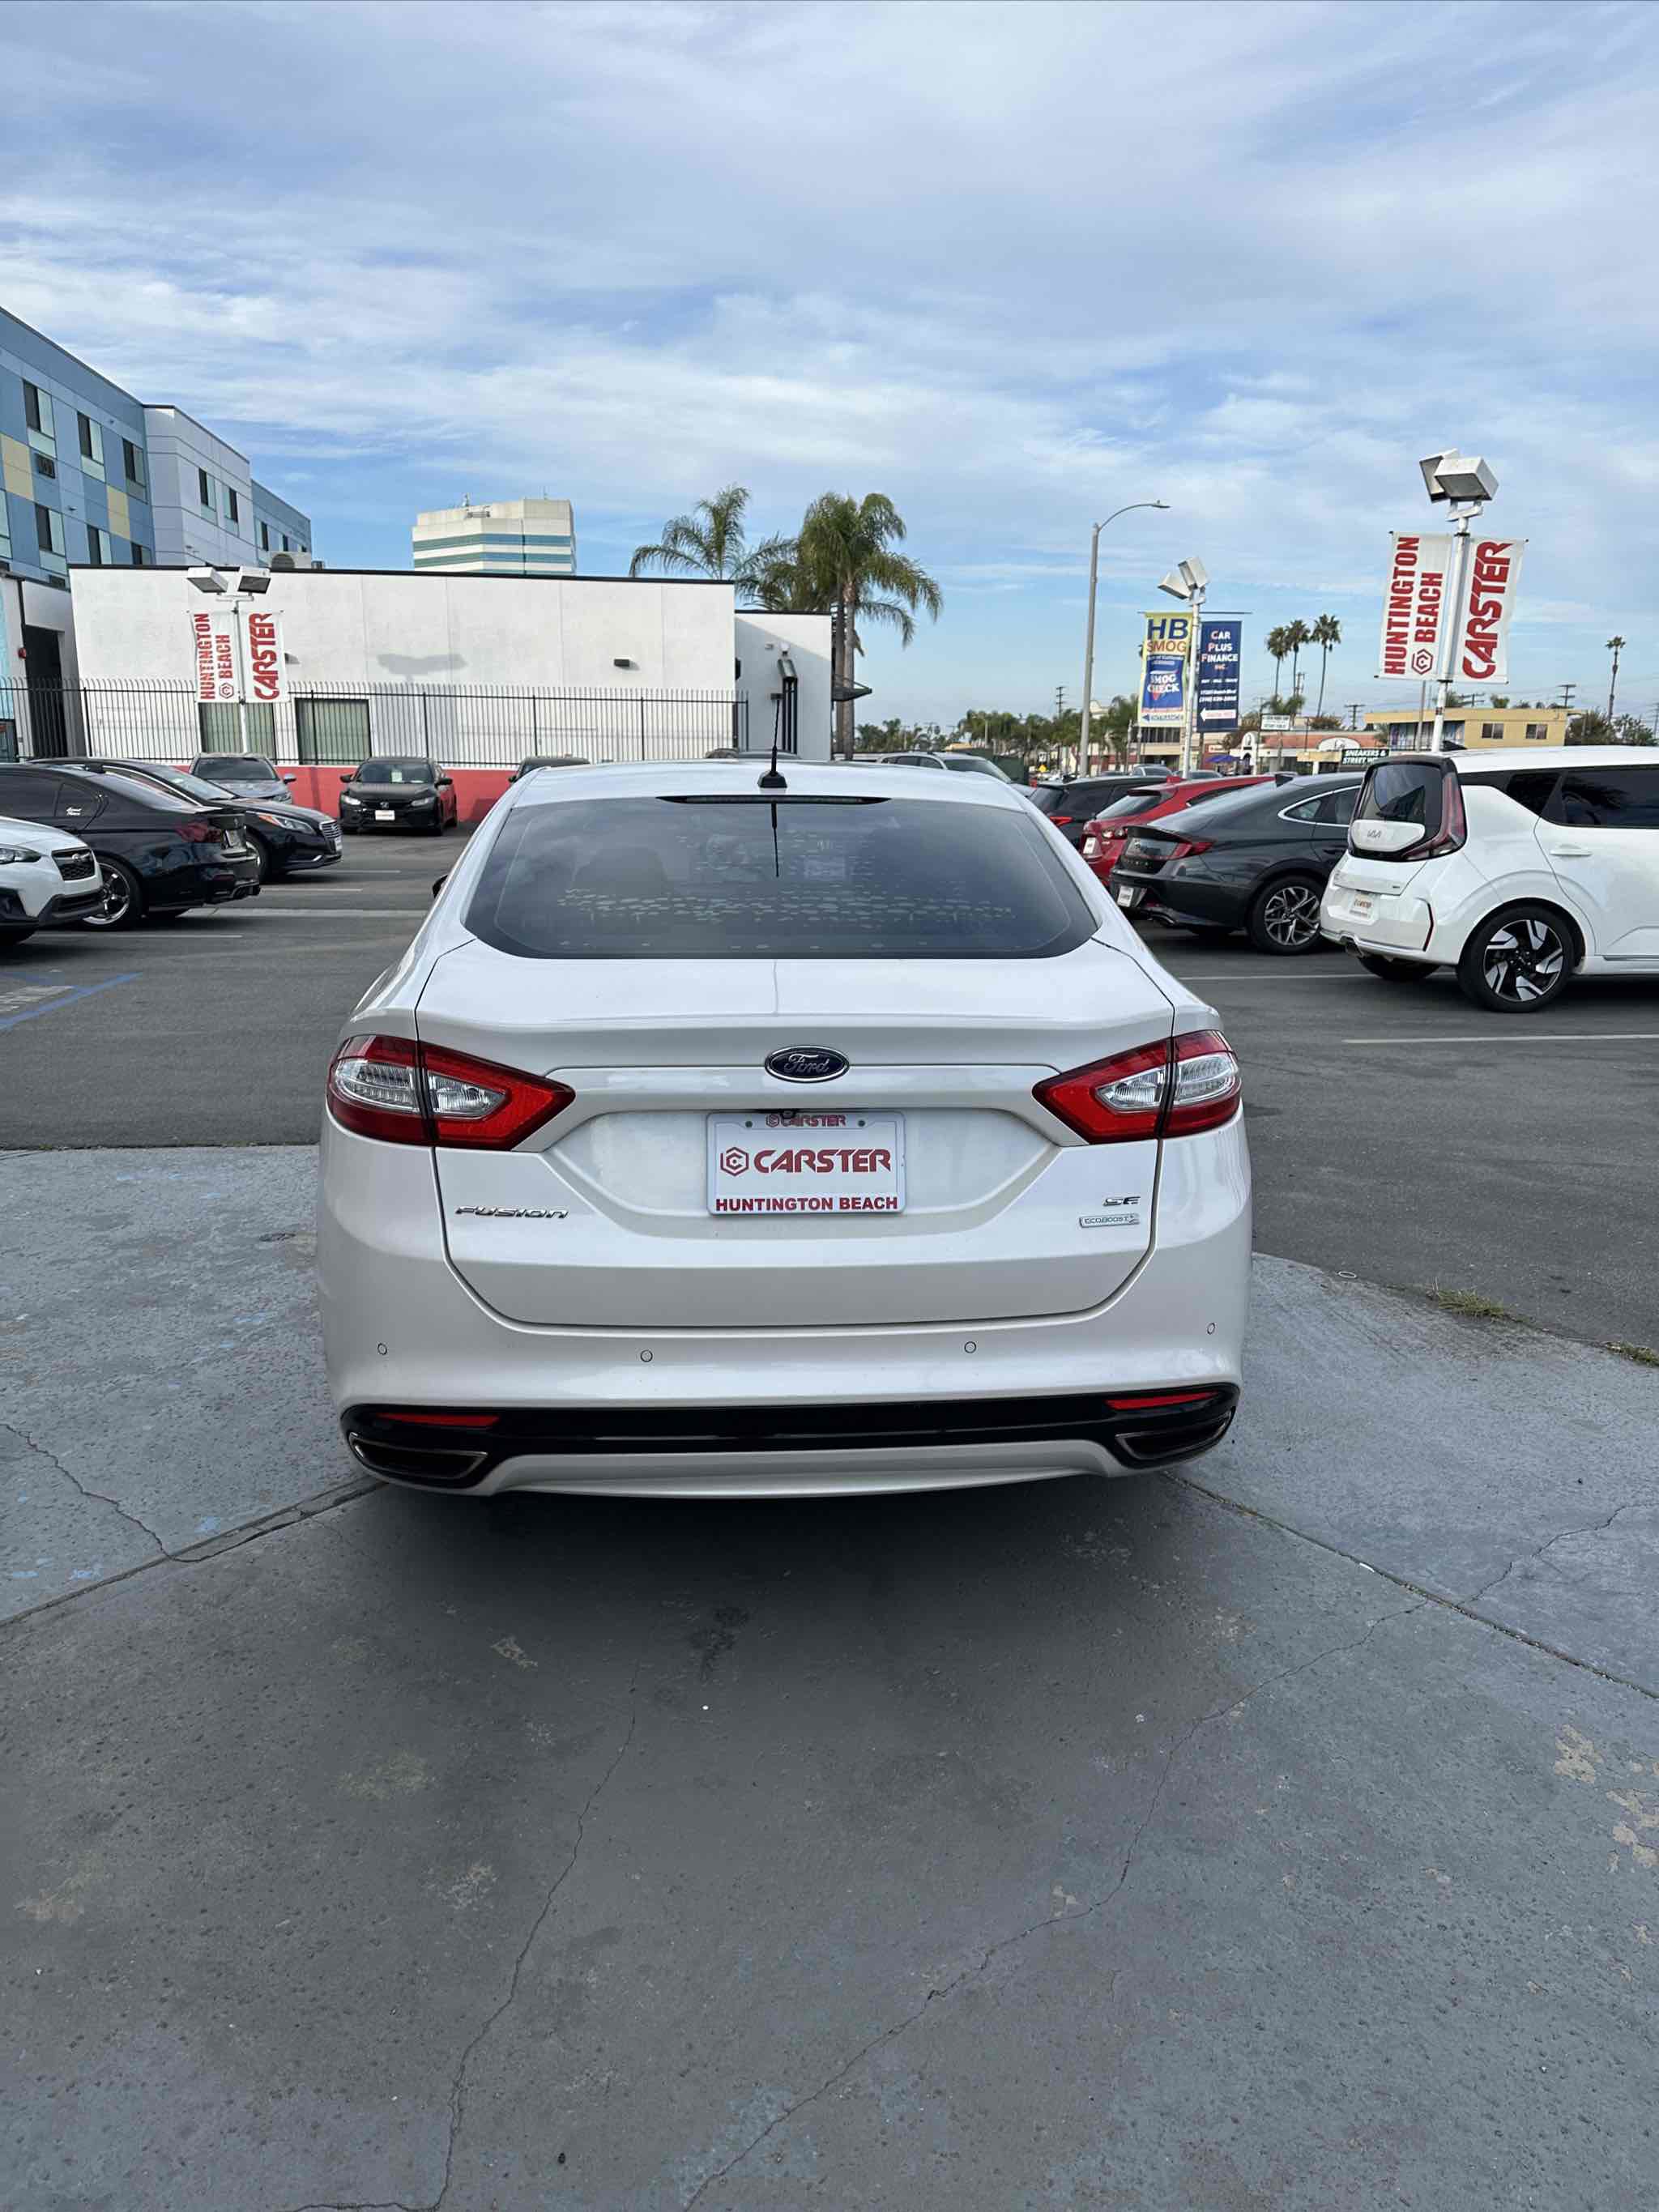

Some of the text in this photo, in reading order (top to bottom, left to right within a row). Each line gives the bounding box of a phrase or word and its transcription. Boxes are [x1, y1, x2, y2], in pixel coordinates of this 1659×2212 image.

[1384, 536, 1419, 675] HUNTINGTON
[1414, 572, 1443, 643] BEACH
[1462, 541, 1513, 680] CARSTER
[1147, 619, 1188, 640] HB
[1211, 631, 1230, 640] CAR
[194, 613, 215, 700] HUNTINGTON
[215, 634, 233, 679] BEACH
[249, 612, 279, 701] CARSTER
[1147, 640, 1187, 653] SMOG
[1208, 642, 1232, 651] PLUS
[1201, 654, 1238, 663] FINANCE
[1147, 683, 1180, 693] CHECK
[1151, 674, 1177, 684] SMOG
[783, 1053, 830, 1073] Ford
[753, 1149, 891, 1173] CARSTER
[716, 1196, 898, 1212] HUNTINGTON BEACH
[1102, 1196, 1141, 1207] SE
